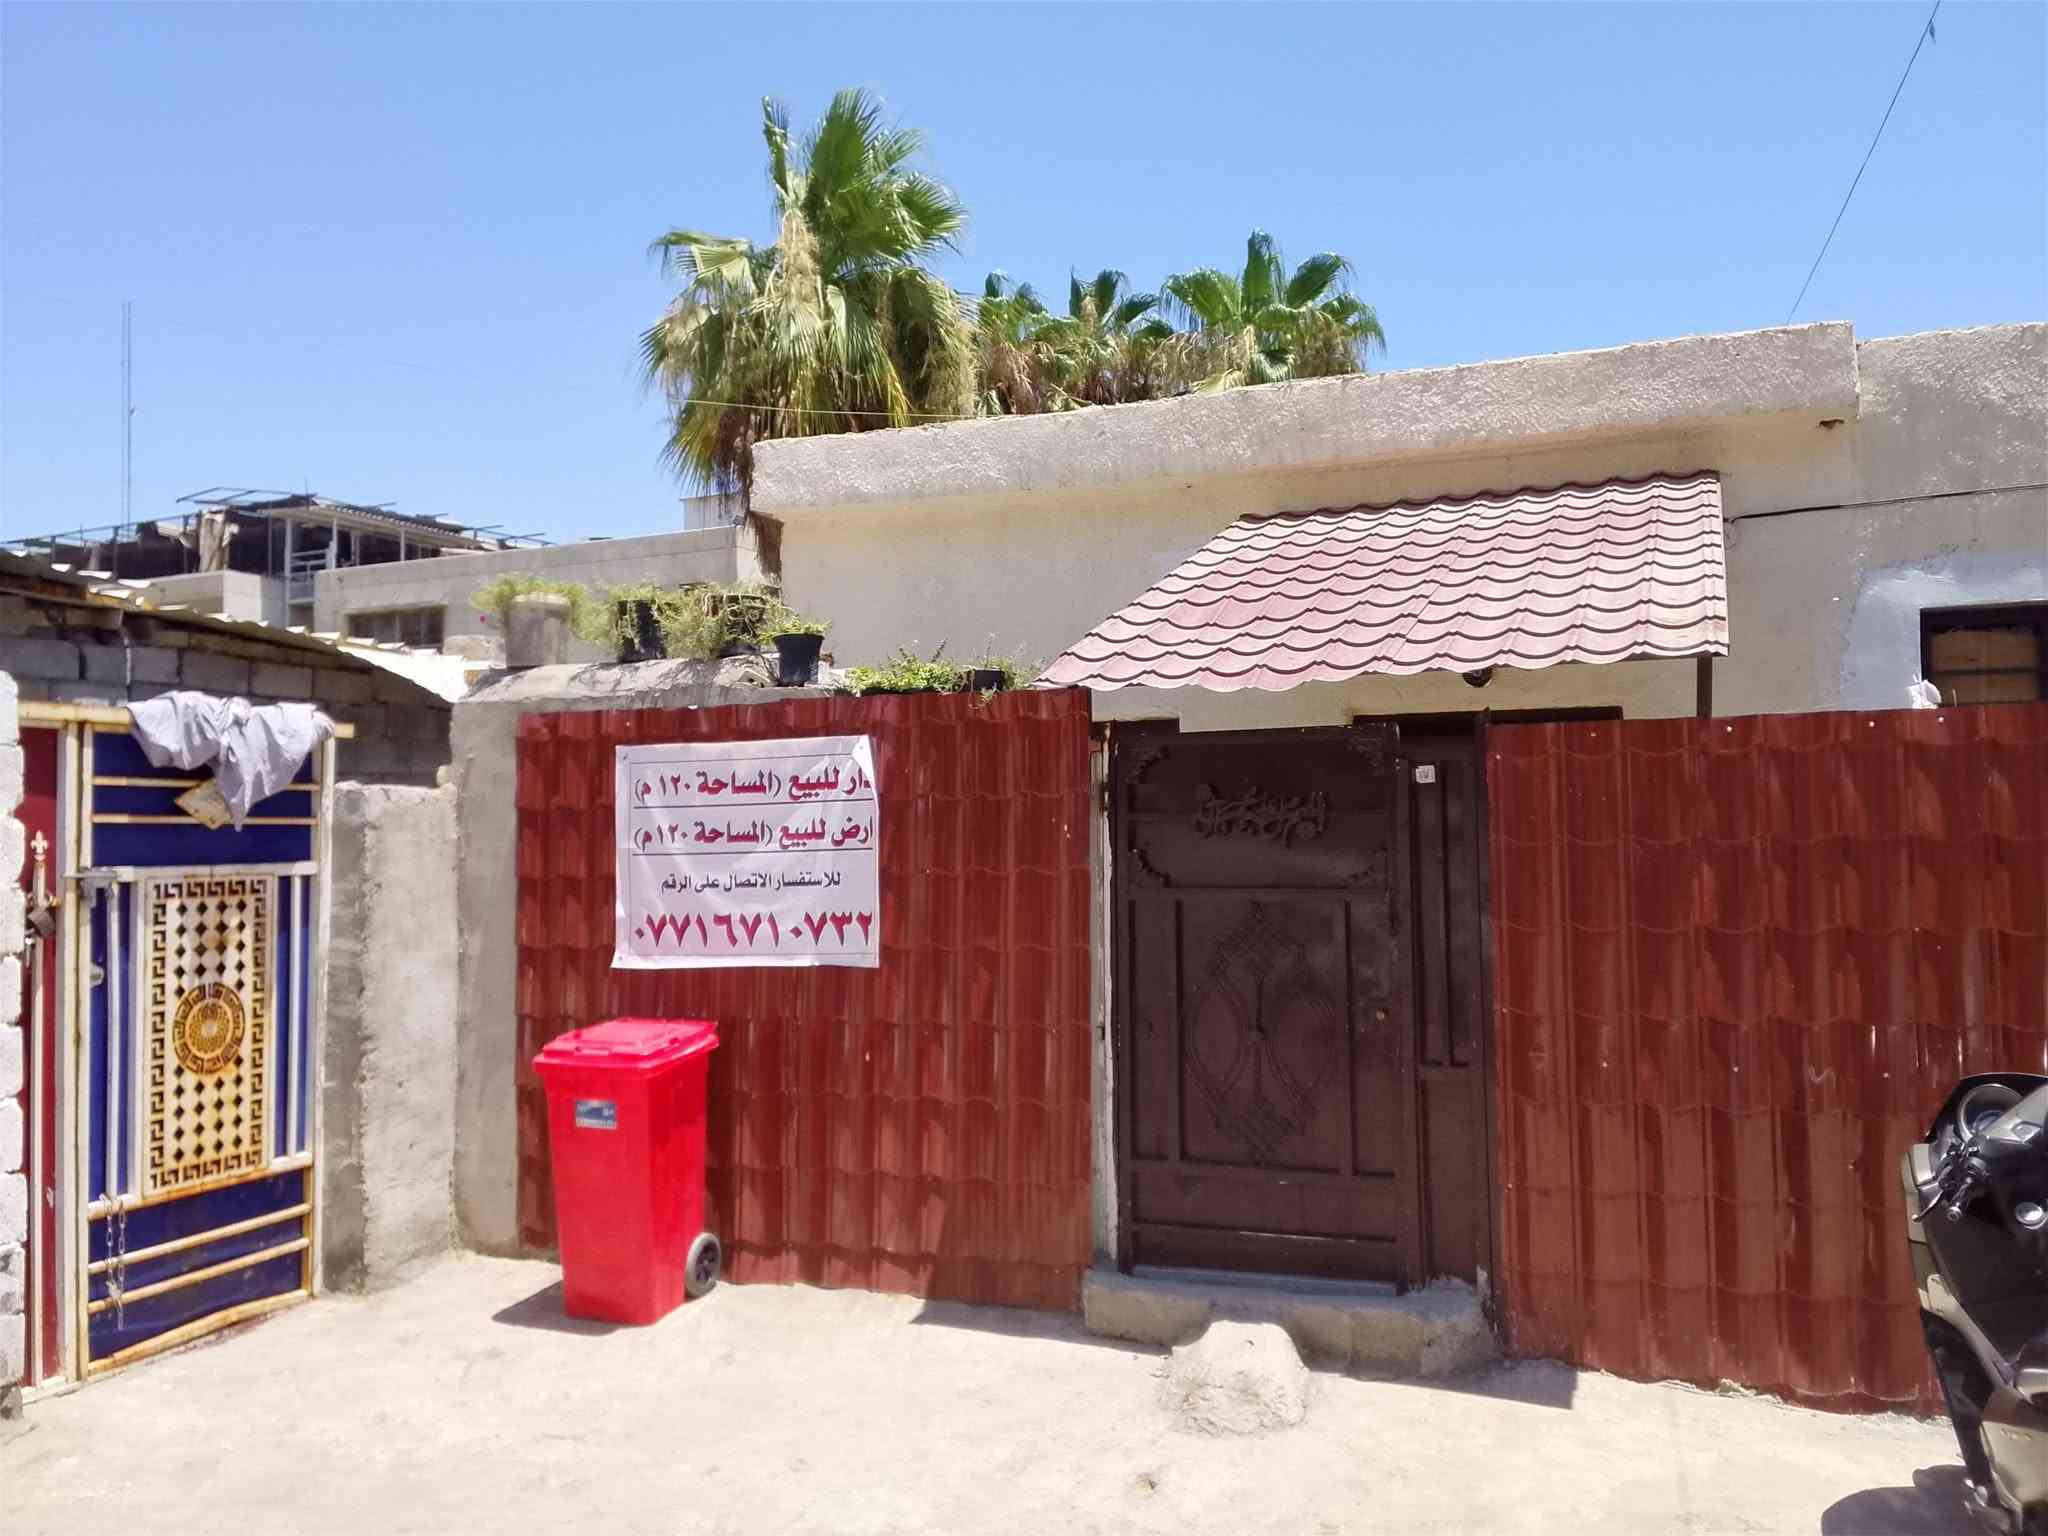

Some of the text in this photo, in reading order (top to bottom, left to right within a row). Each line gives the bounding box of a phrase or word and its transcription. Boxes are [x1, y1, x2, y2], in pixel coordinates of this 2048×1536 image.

[695, 769, 782, 798] (المساحة
[788, 766, 840, 801] للبيع
[694, 820, 773, 847] (المساحة
[779, 817, 826, 849] للبيع
[831, 816, 873, 847] ارض
[661, 871, 841, 895] للاستفسار الاتصال على الرقم
[634, 911, 873, 948] ٠٧٧١٦٧١٠٧٣٢
